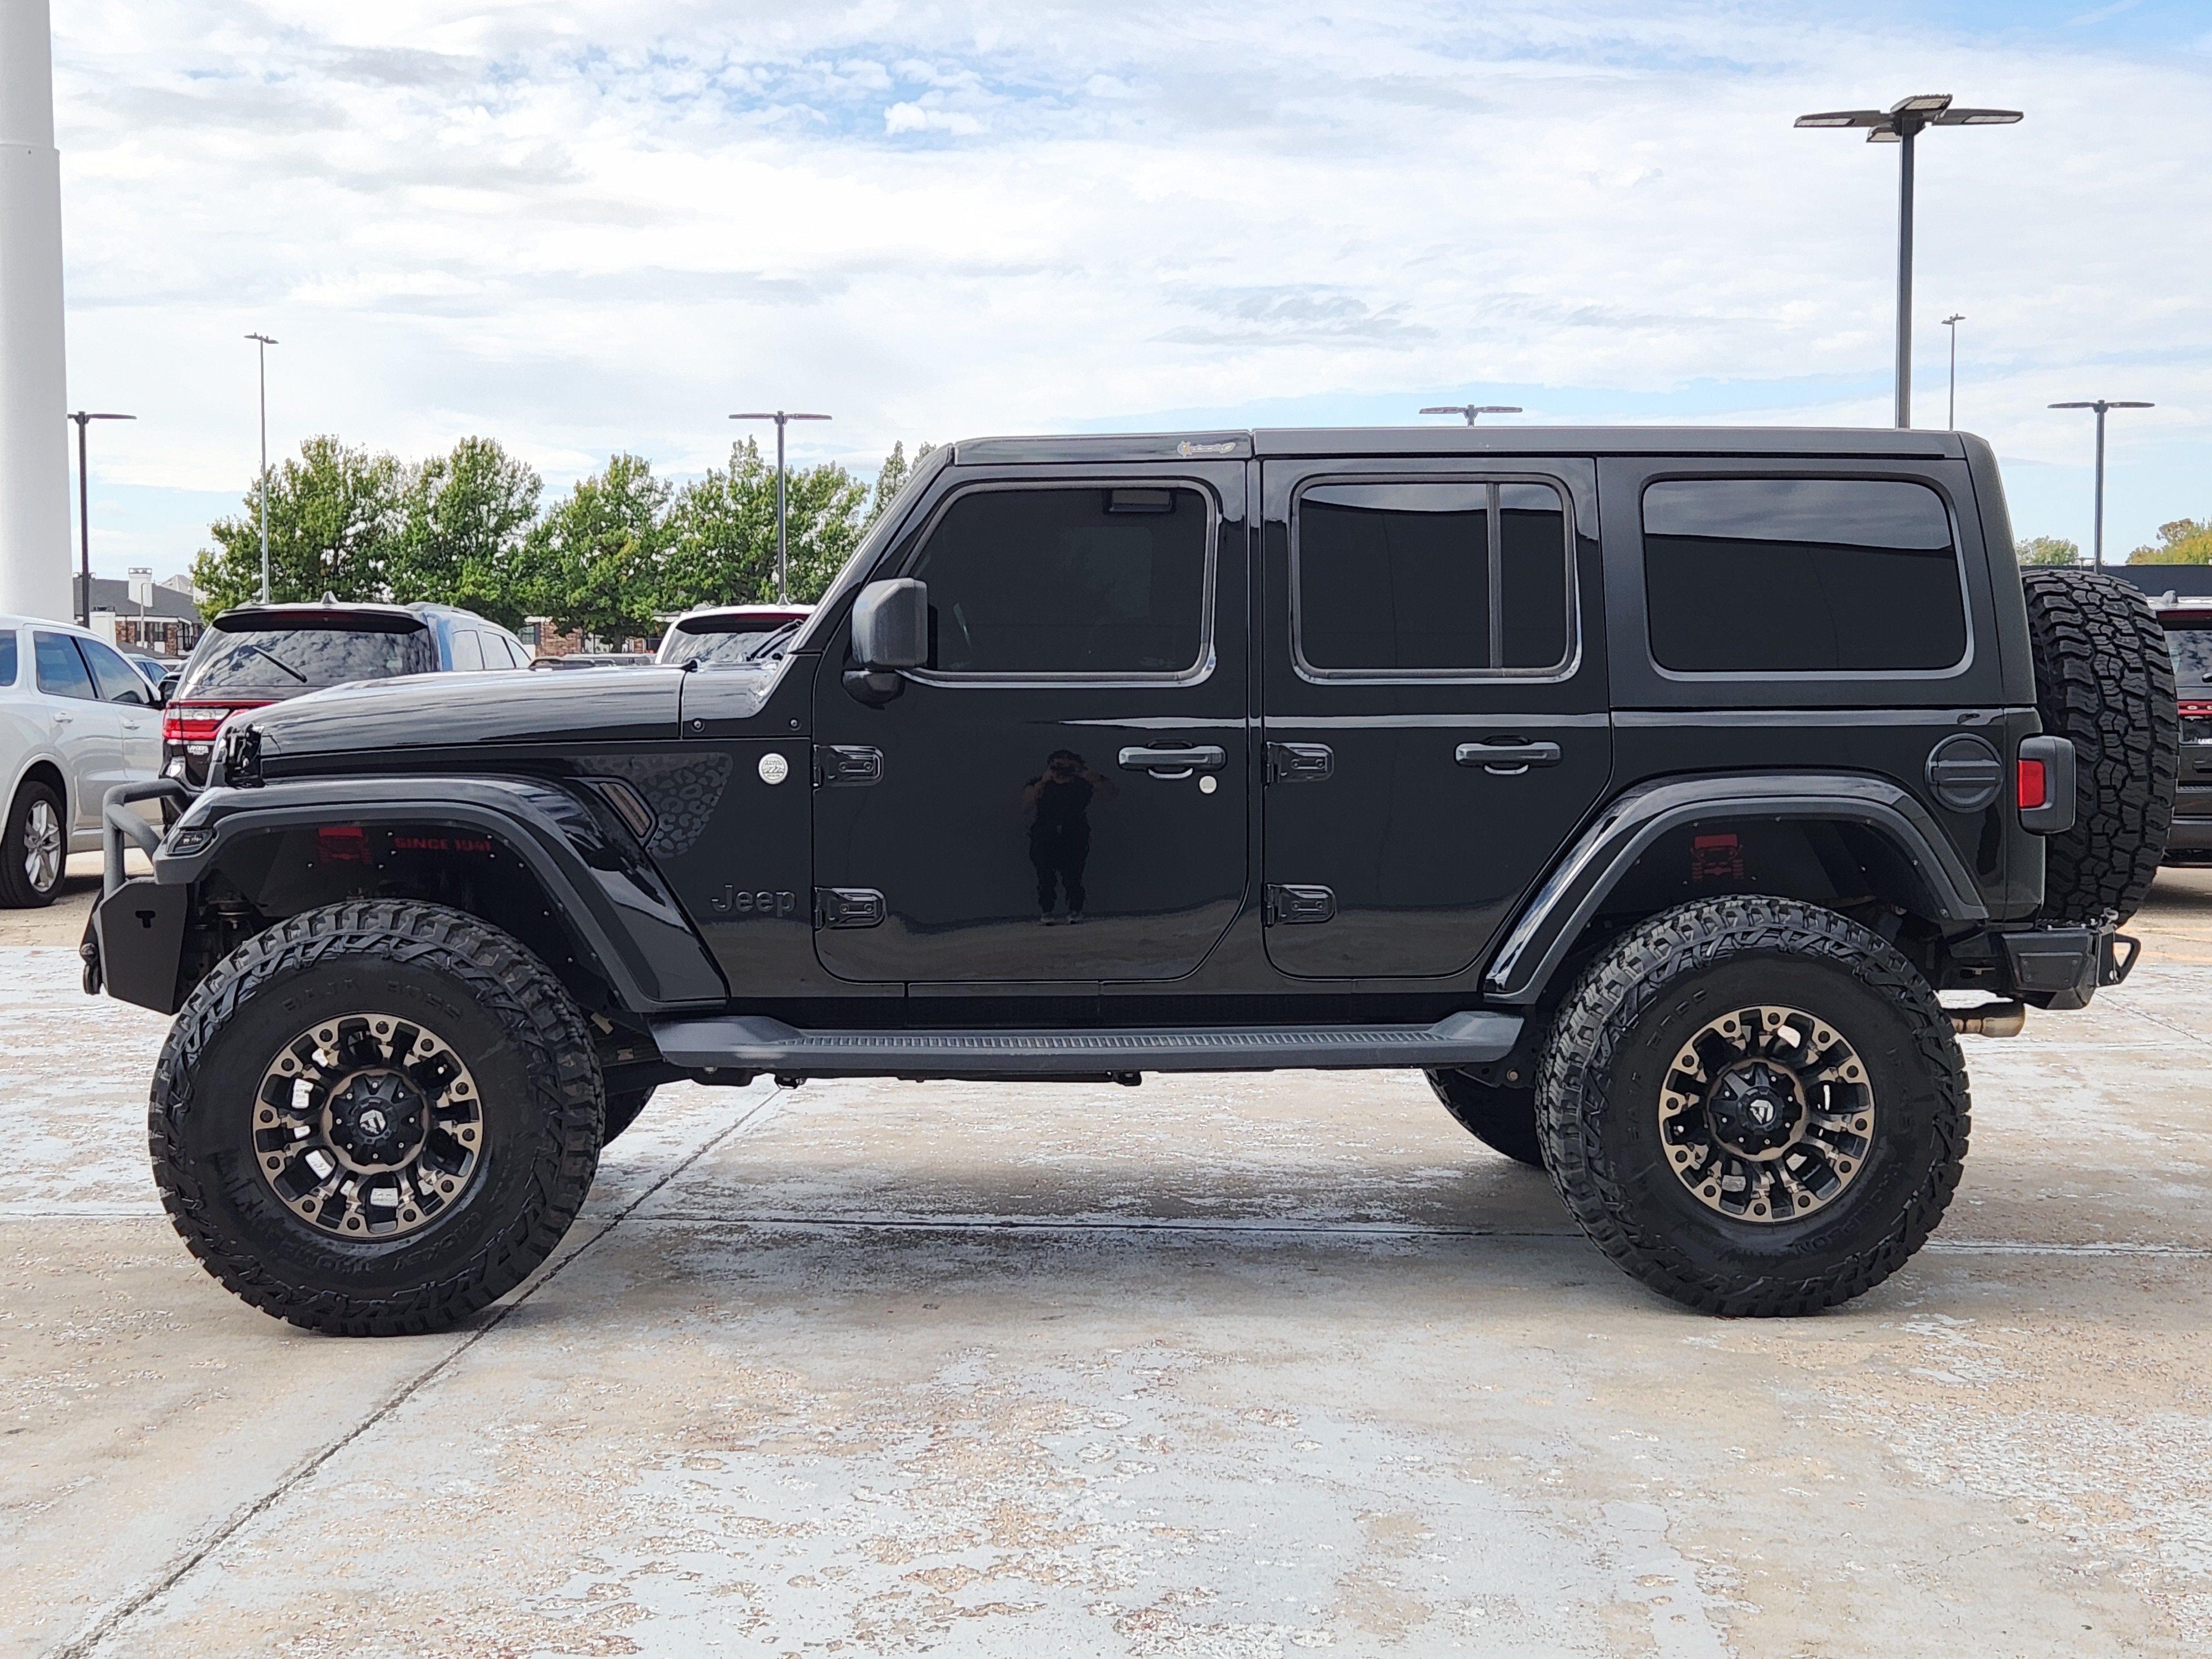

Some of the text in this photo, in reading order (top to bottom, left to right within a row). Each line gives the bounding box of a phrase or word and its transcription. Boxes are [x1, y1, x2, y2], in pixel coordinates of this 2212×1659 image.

[394, 837, 491, 852] SINCE 1941
[711, 884, 796, 917] Jeep
[360, 1123, 380, 1134] FUEL
